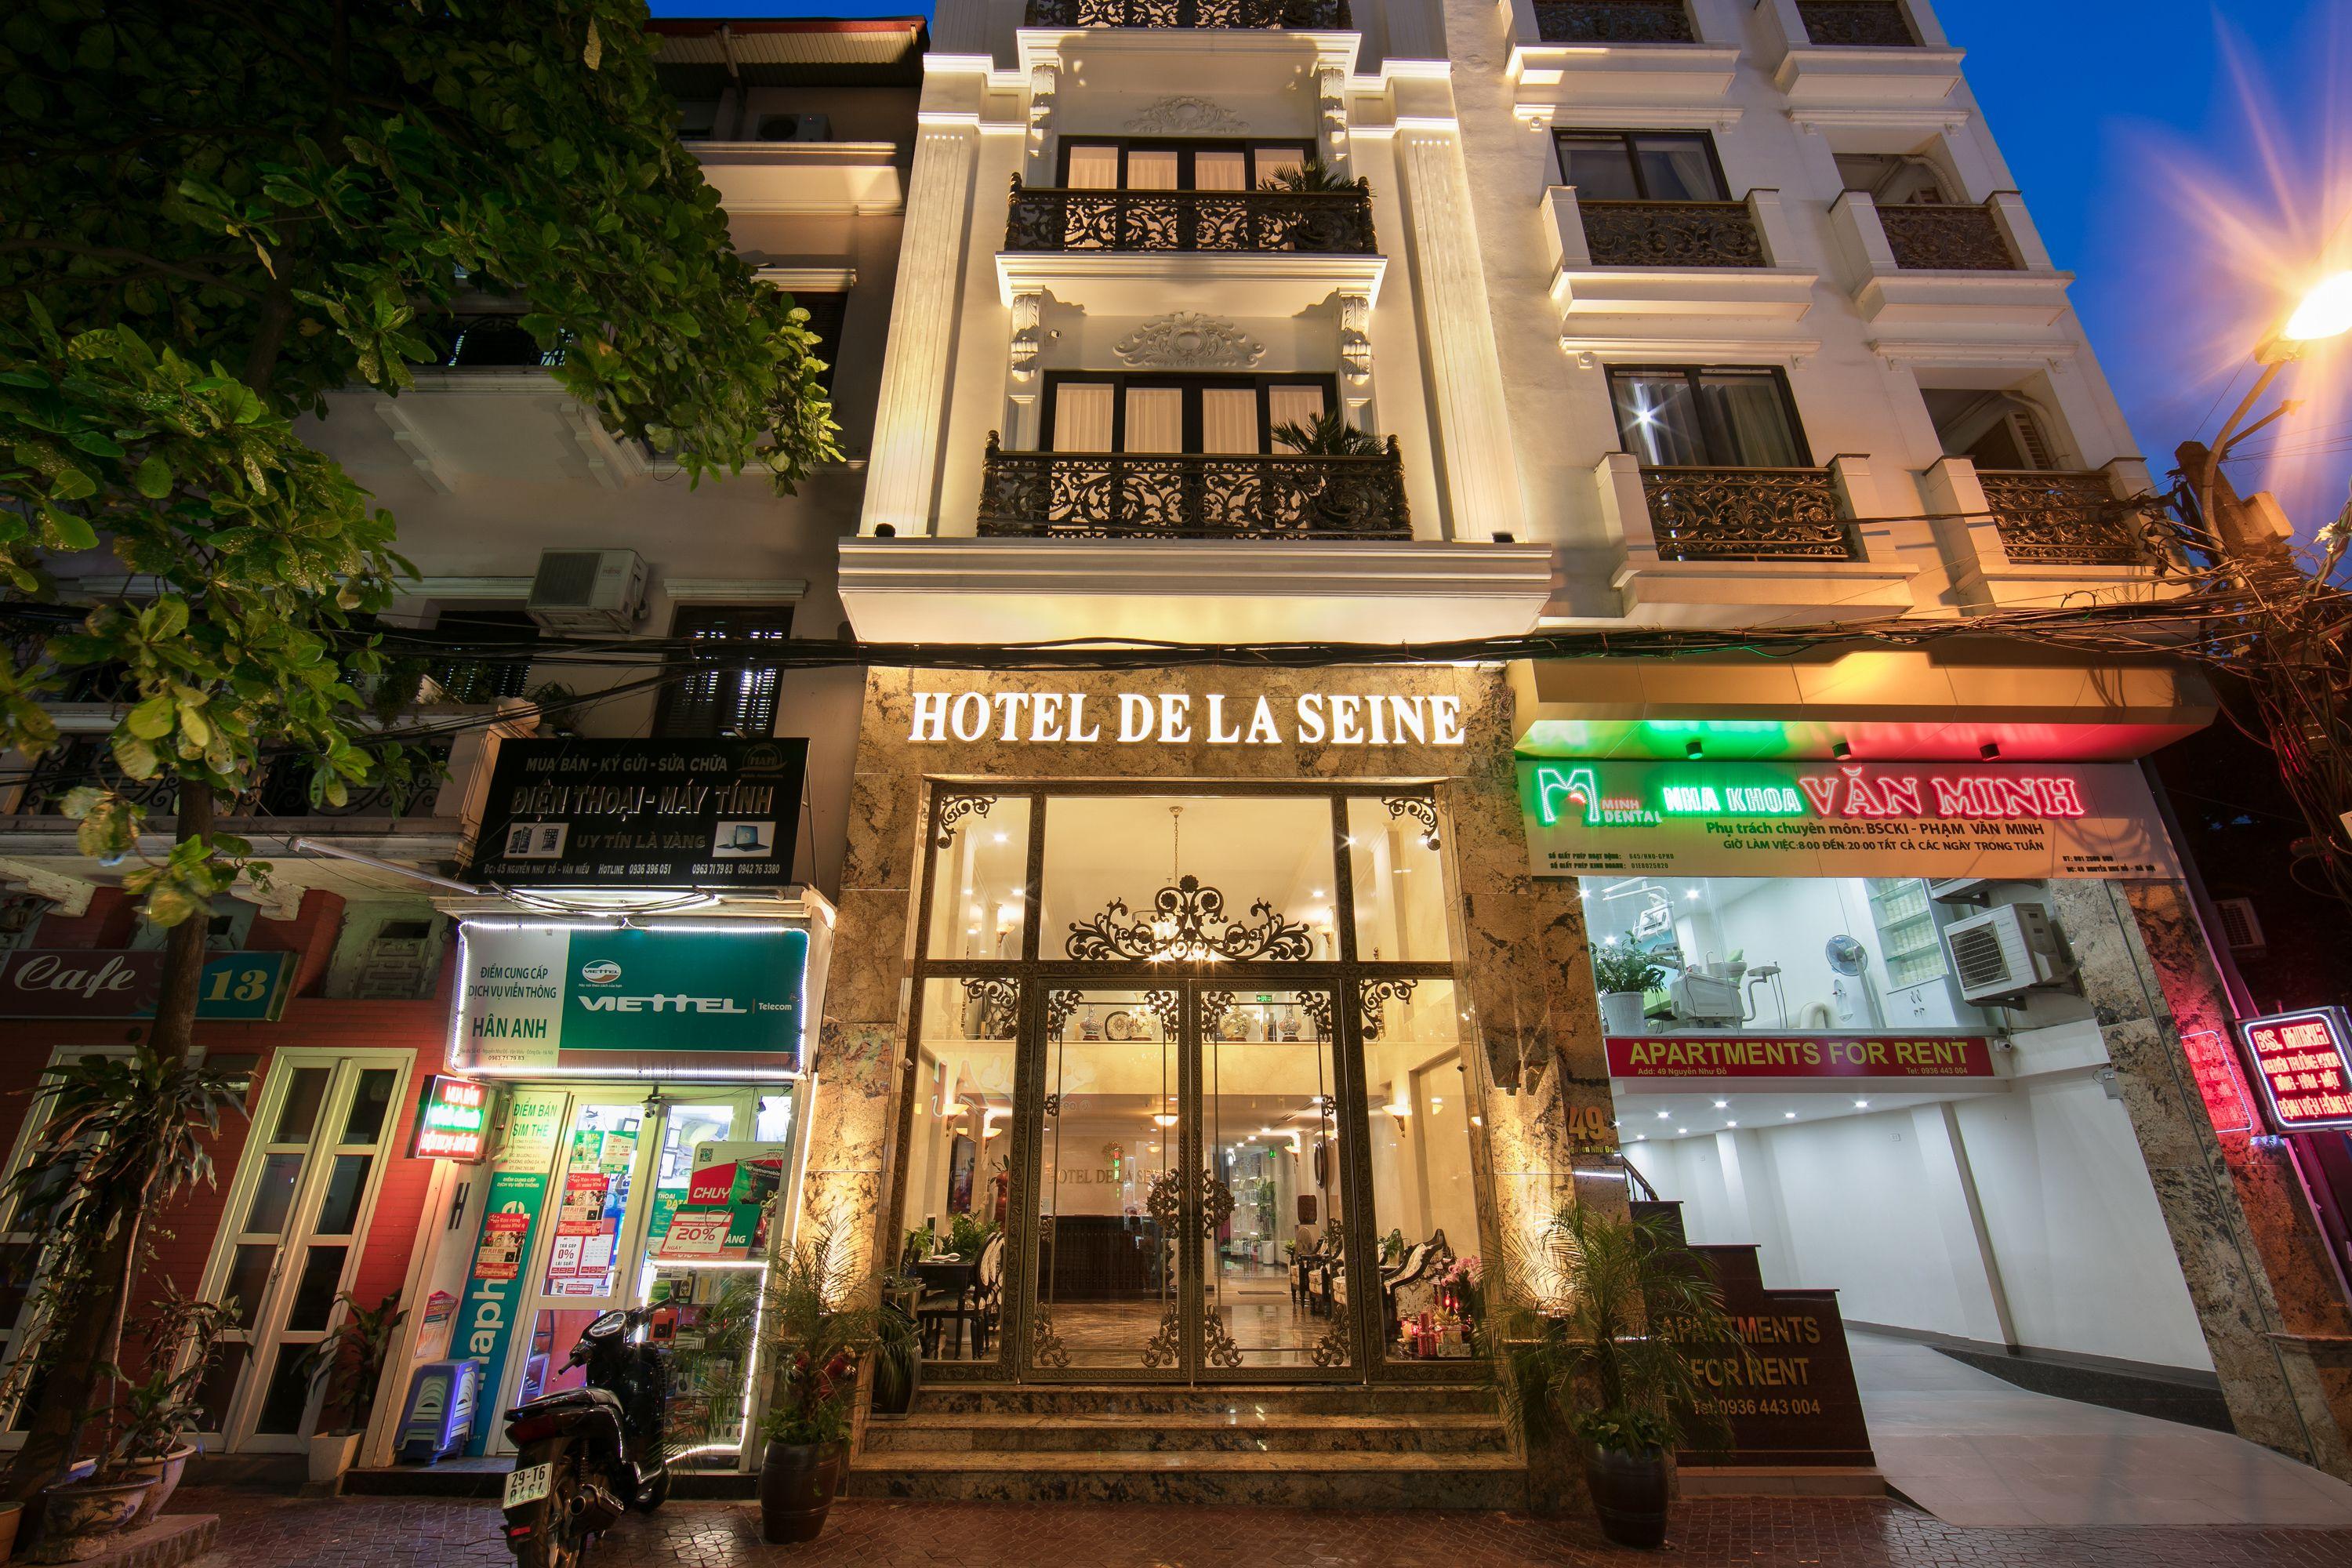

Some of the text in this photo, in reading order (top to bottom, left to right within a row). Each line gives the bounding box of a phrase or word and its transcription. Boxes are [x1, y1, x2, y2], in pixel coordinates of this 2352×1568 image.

[907, 691, 1465, 745] HOTEL DE LA SEINE
[525, 752, 728, 771] MUA BÁN KÝ GỬI SỬA CHỮA
[1662, 766, 2086, 815] NHA KHOA VĂN MINH
[509, 779, 570, 822] ĐIỆN
[714, 779, 775, 815] TÍNH
[1601, 798, 1640, 810] MINH
[1603, 810, 1664, 823] DENTAL
[1706, 820, 2044, 837] Phụ trách chuyên môn: BSCKI PHẠM VĂN MINH
[576, 831, 706, 848] UY TÍN LÀ VÀNG
[1723, 837, 1743, 849] GIỜ
[1747, 837, 1770, 849] LÀM
[1877, 837, 1897, 850] TẤT
[1900, 837, 1915, 850] CẢ
[1918, 837, 1940, 850] CÁC
[1942, 837, 1971, 851] NGÀY
[1974, 841, 2013, 851] TRONG
[2015, 838, 2045, 851] TUẦN
[497, 864, 506, 873] 45
[629, 864, 645, 874] 0936
[647, 864, 659, 874] 396
[659, 864, 672, 874] 051
[692, 864, 708, 874] 0963
[738, 864, 780, 874] 0942 76 3380
[14, 954, 268, 1002] Cafe 13
[480, 964, 549, 979] ĐIỂM CUNG CẤP
[468, 982, 557, 1001] DỊCH VỤ VIỄN THÔNG
[758, 1001, 793, 1011] Telecom
[472, 1014, 547, 1039] HÂN ANH
[1629, 1041, 1969, 1065] APARTMENTS FOR RENT
[1668, 1067, 1697, 1076] Nguyễn
[513, 1097, 557, 1116] ĐIỂM BÁN
[512, 1119, 550, 1137] SIM THẺ
[1568, 1105, 1606, 1140] 49
[1095, 1169, 1114, 1184] DE
[676, 1228, 716, 1240] 20%
[557, 1249, 574, 1259] 0%
[1690, 1356, 1809, 1386] FOR RENT
[1719, 1398, 1821, 1415] 0936 443 004
[511, 1465, 546, 1489] 29-T6
